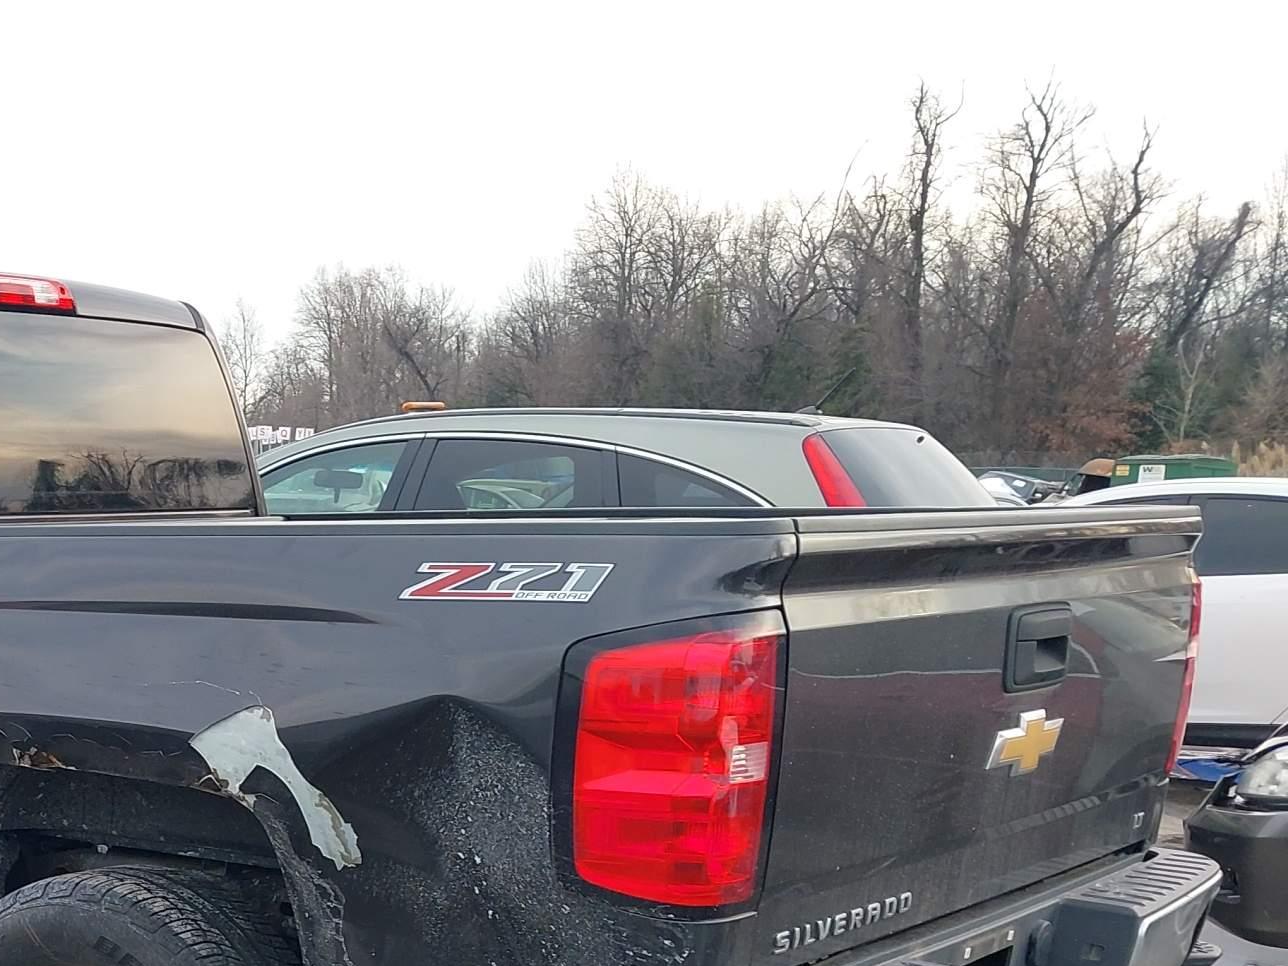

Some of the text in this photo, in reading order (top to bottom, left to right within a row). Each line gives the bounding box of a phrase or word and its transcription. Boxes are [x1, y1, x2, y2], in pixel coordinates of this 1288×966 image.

[280, 429, 288, 438] Q
[398, 562, 615, 600] Z71
[545, 592, 589, 600] ROAD
[773, 892, 913, 954] SILVERADO
